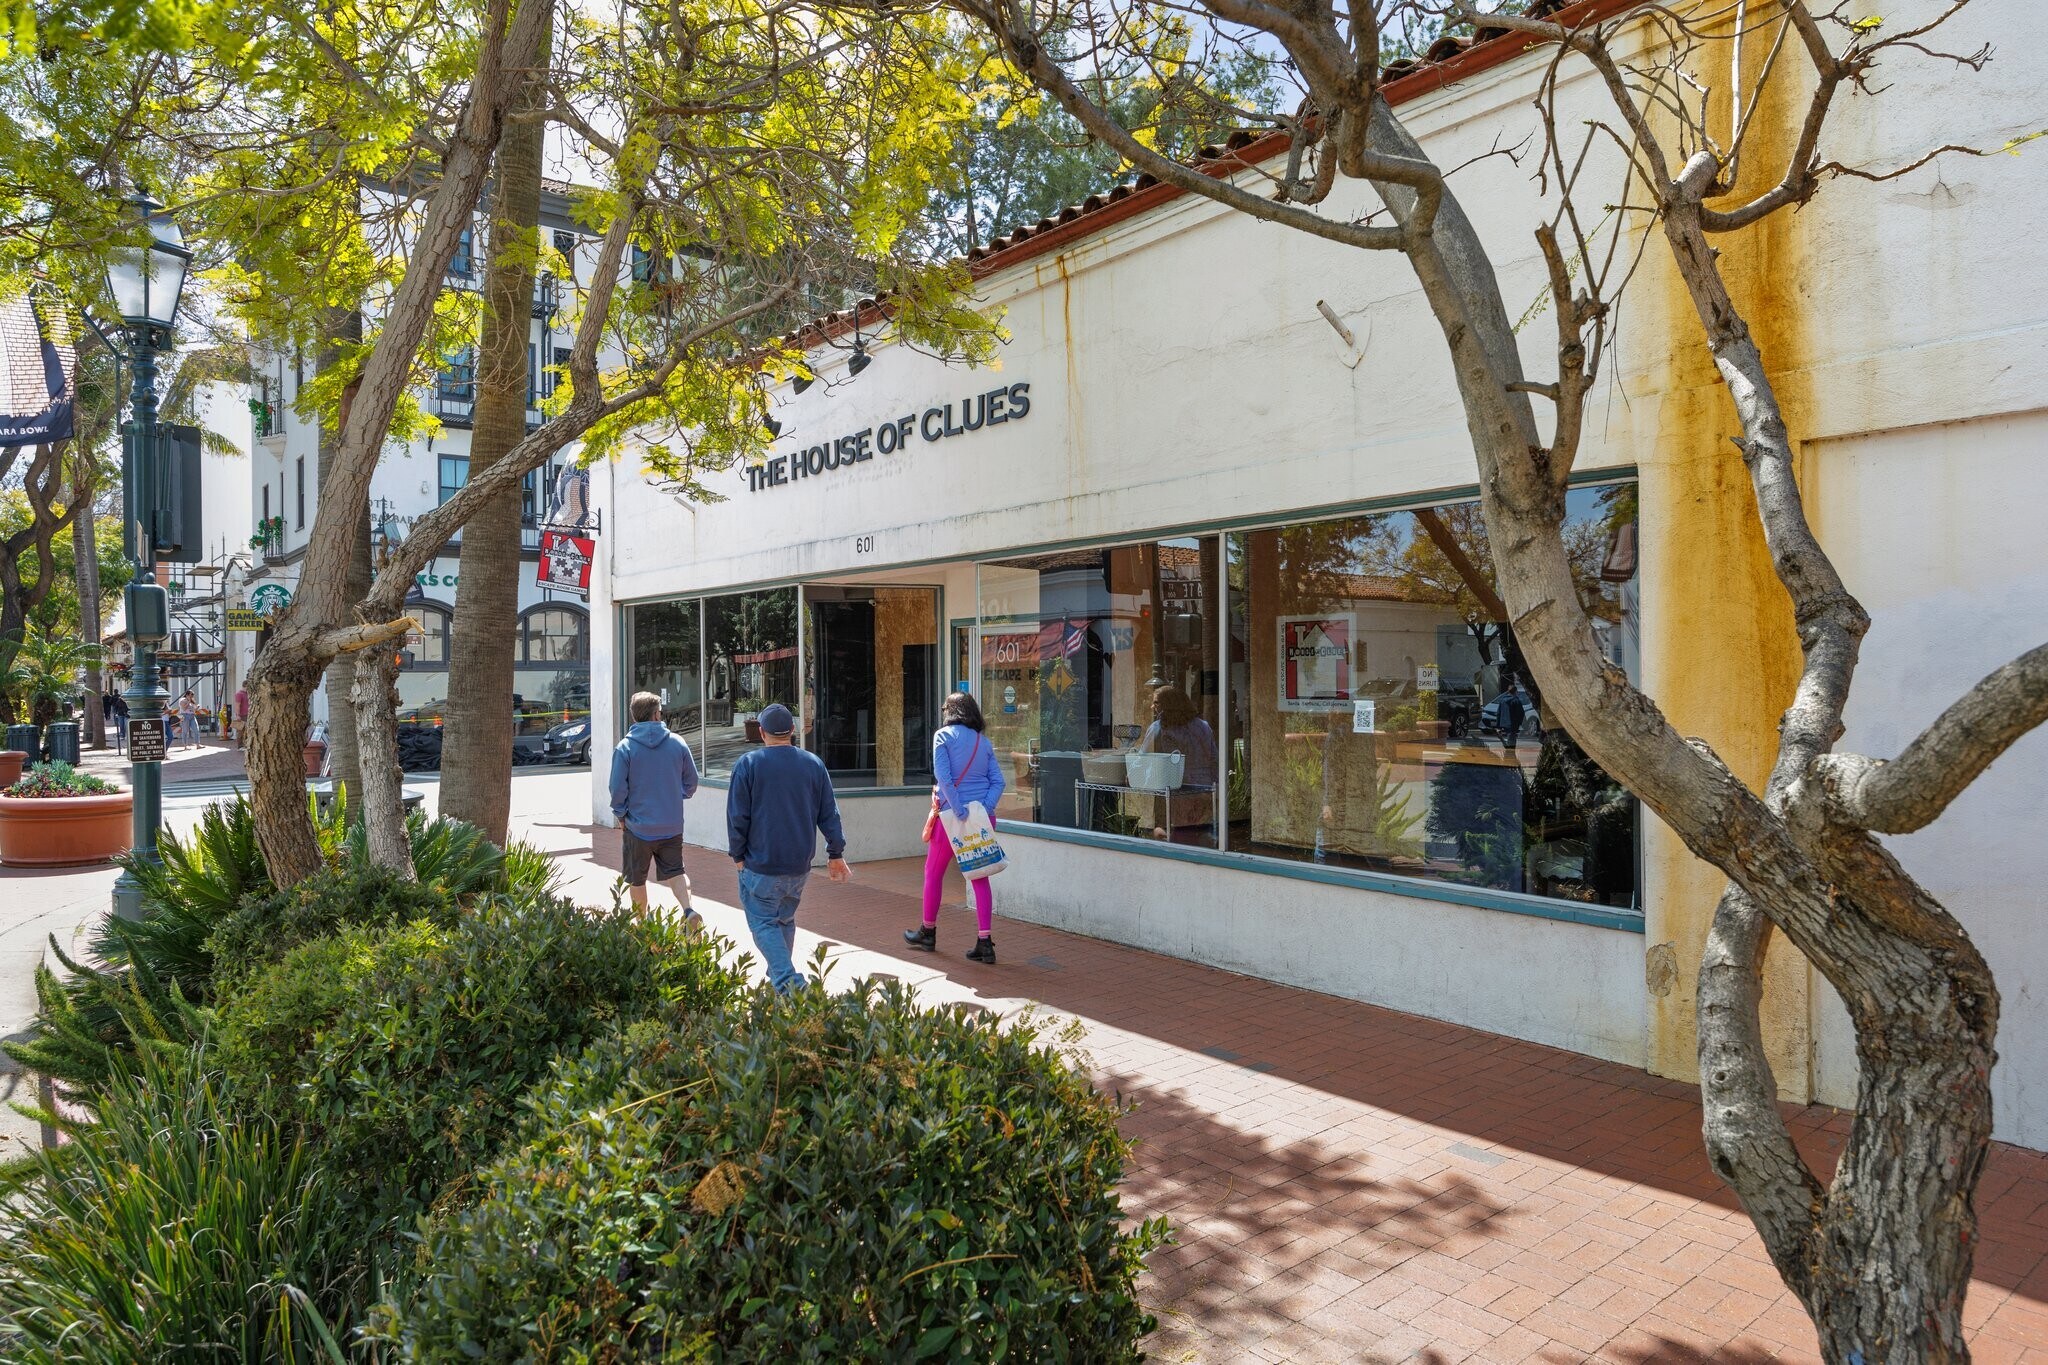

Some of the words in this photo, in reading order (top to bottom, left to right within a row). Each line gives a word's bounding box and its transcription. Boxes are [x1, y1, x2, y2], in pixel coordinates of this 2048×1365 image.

[20, 425, 49, 435] BOWL
[746, 455, 788, 492] THE
[791, 427, 873, 481] HOUSE
[877, 413, 916, 455] OF
[920, 382, 1031, 442] CLUES
[856, 535, 874, 554] 601
[228, 620, 262, 628] SEEKER
[997, 642, 1020, 663] 601
